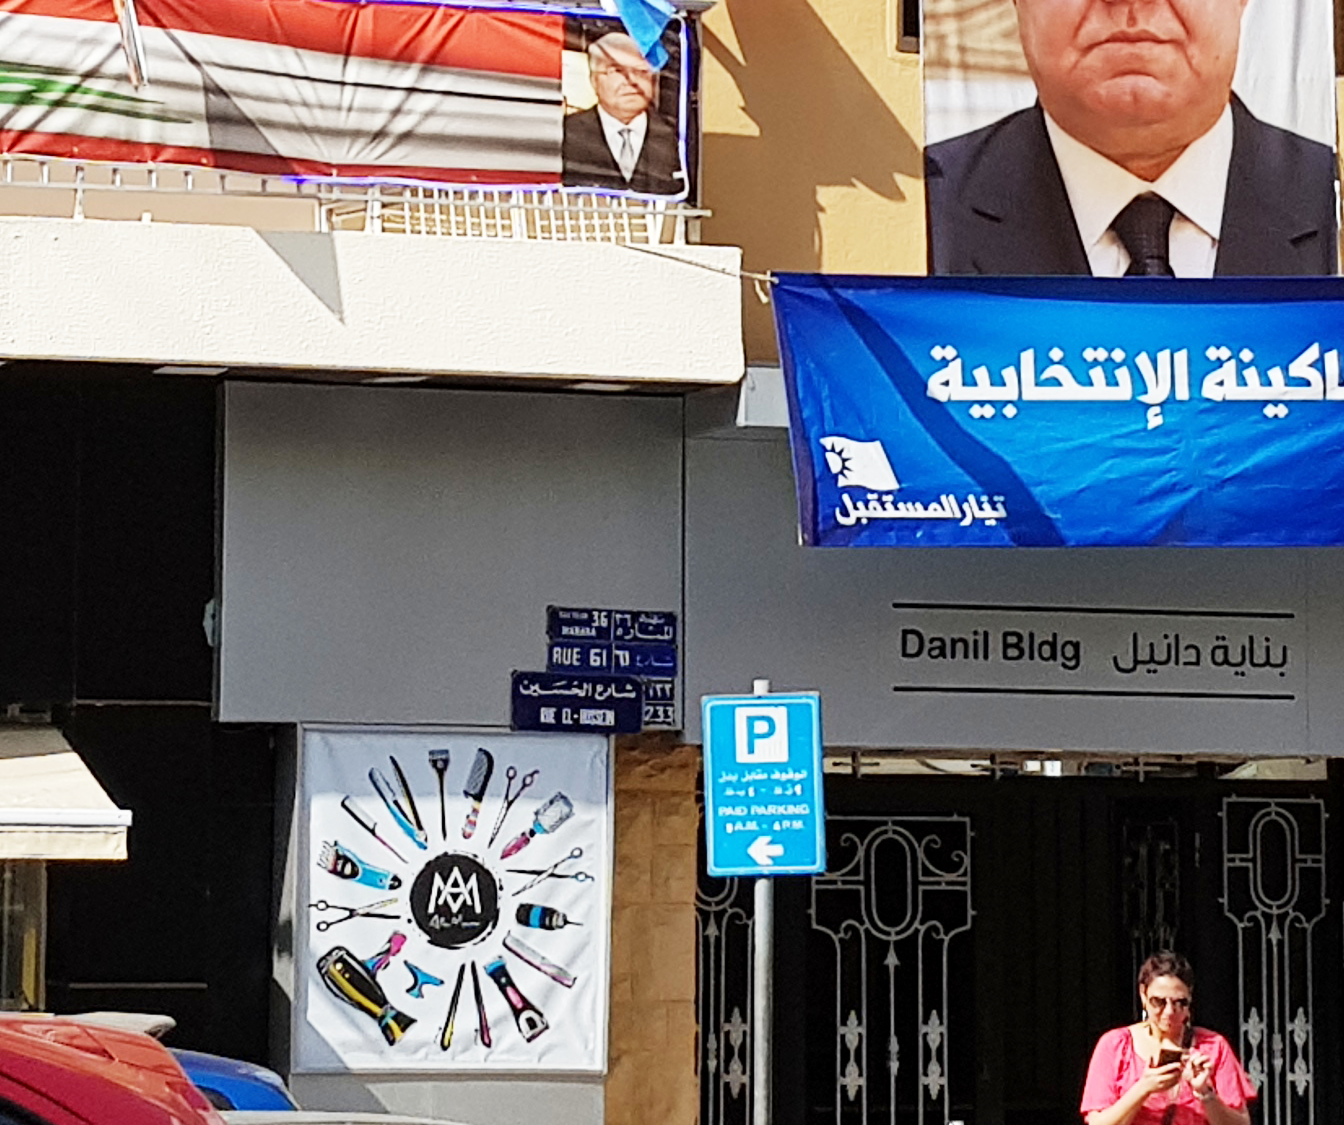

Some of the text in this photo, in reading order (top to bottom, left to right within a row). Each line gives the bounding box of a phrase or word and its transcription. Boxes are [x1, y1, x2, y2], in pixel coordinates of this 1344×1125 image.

[925, 342, 1189, 430] الإنتخابية
[835, 492, 962, 526] المستقبل
[591, 611, 608, 627] 36
[900, 628, 1081, 670] Danil Bldg
[1112, 631, 1288, 677] بناية دانيل
[594, 683, 636, 700] شارع
[747, 715, 775, 755] P
[717, 803, 810, 817] PAID PARKING
